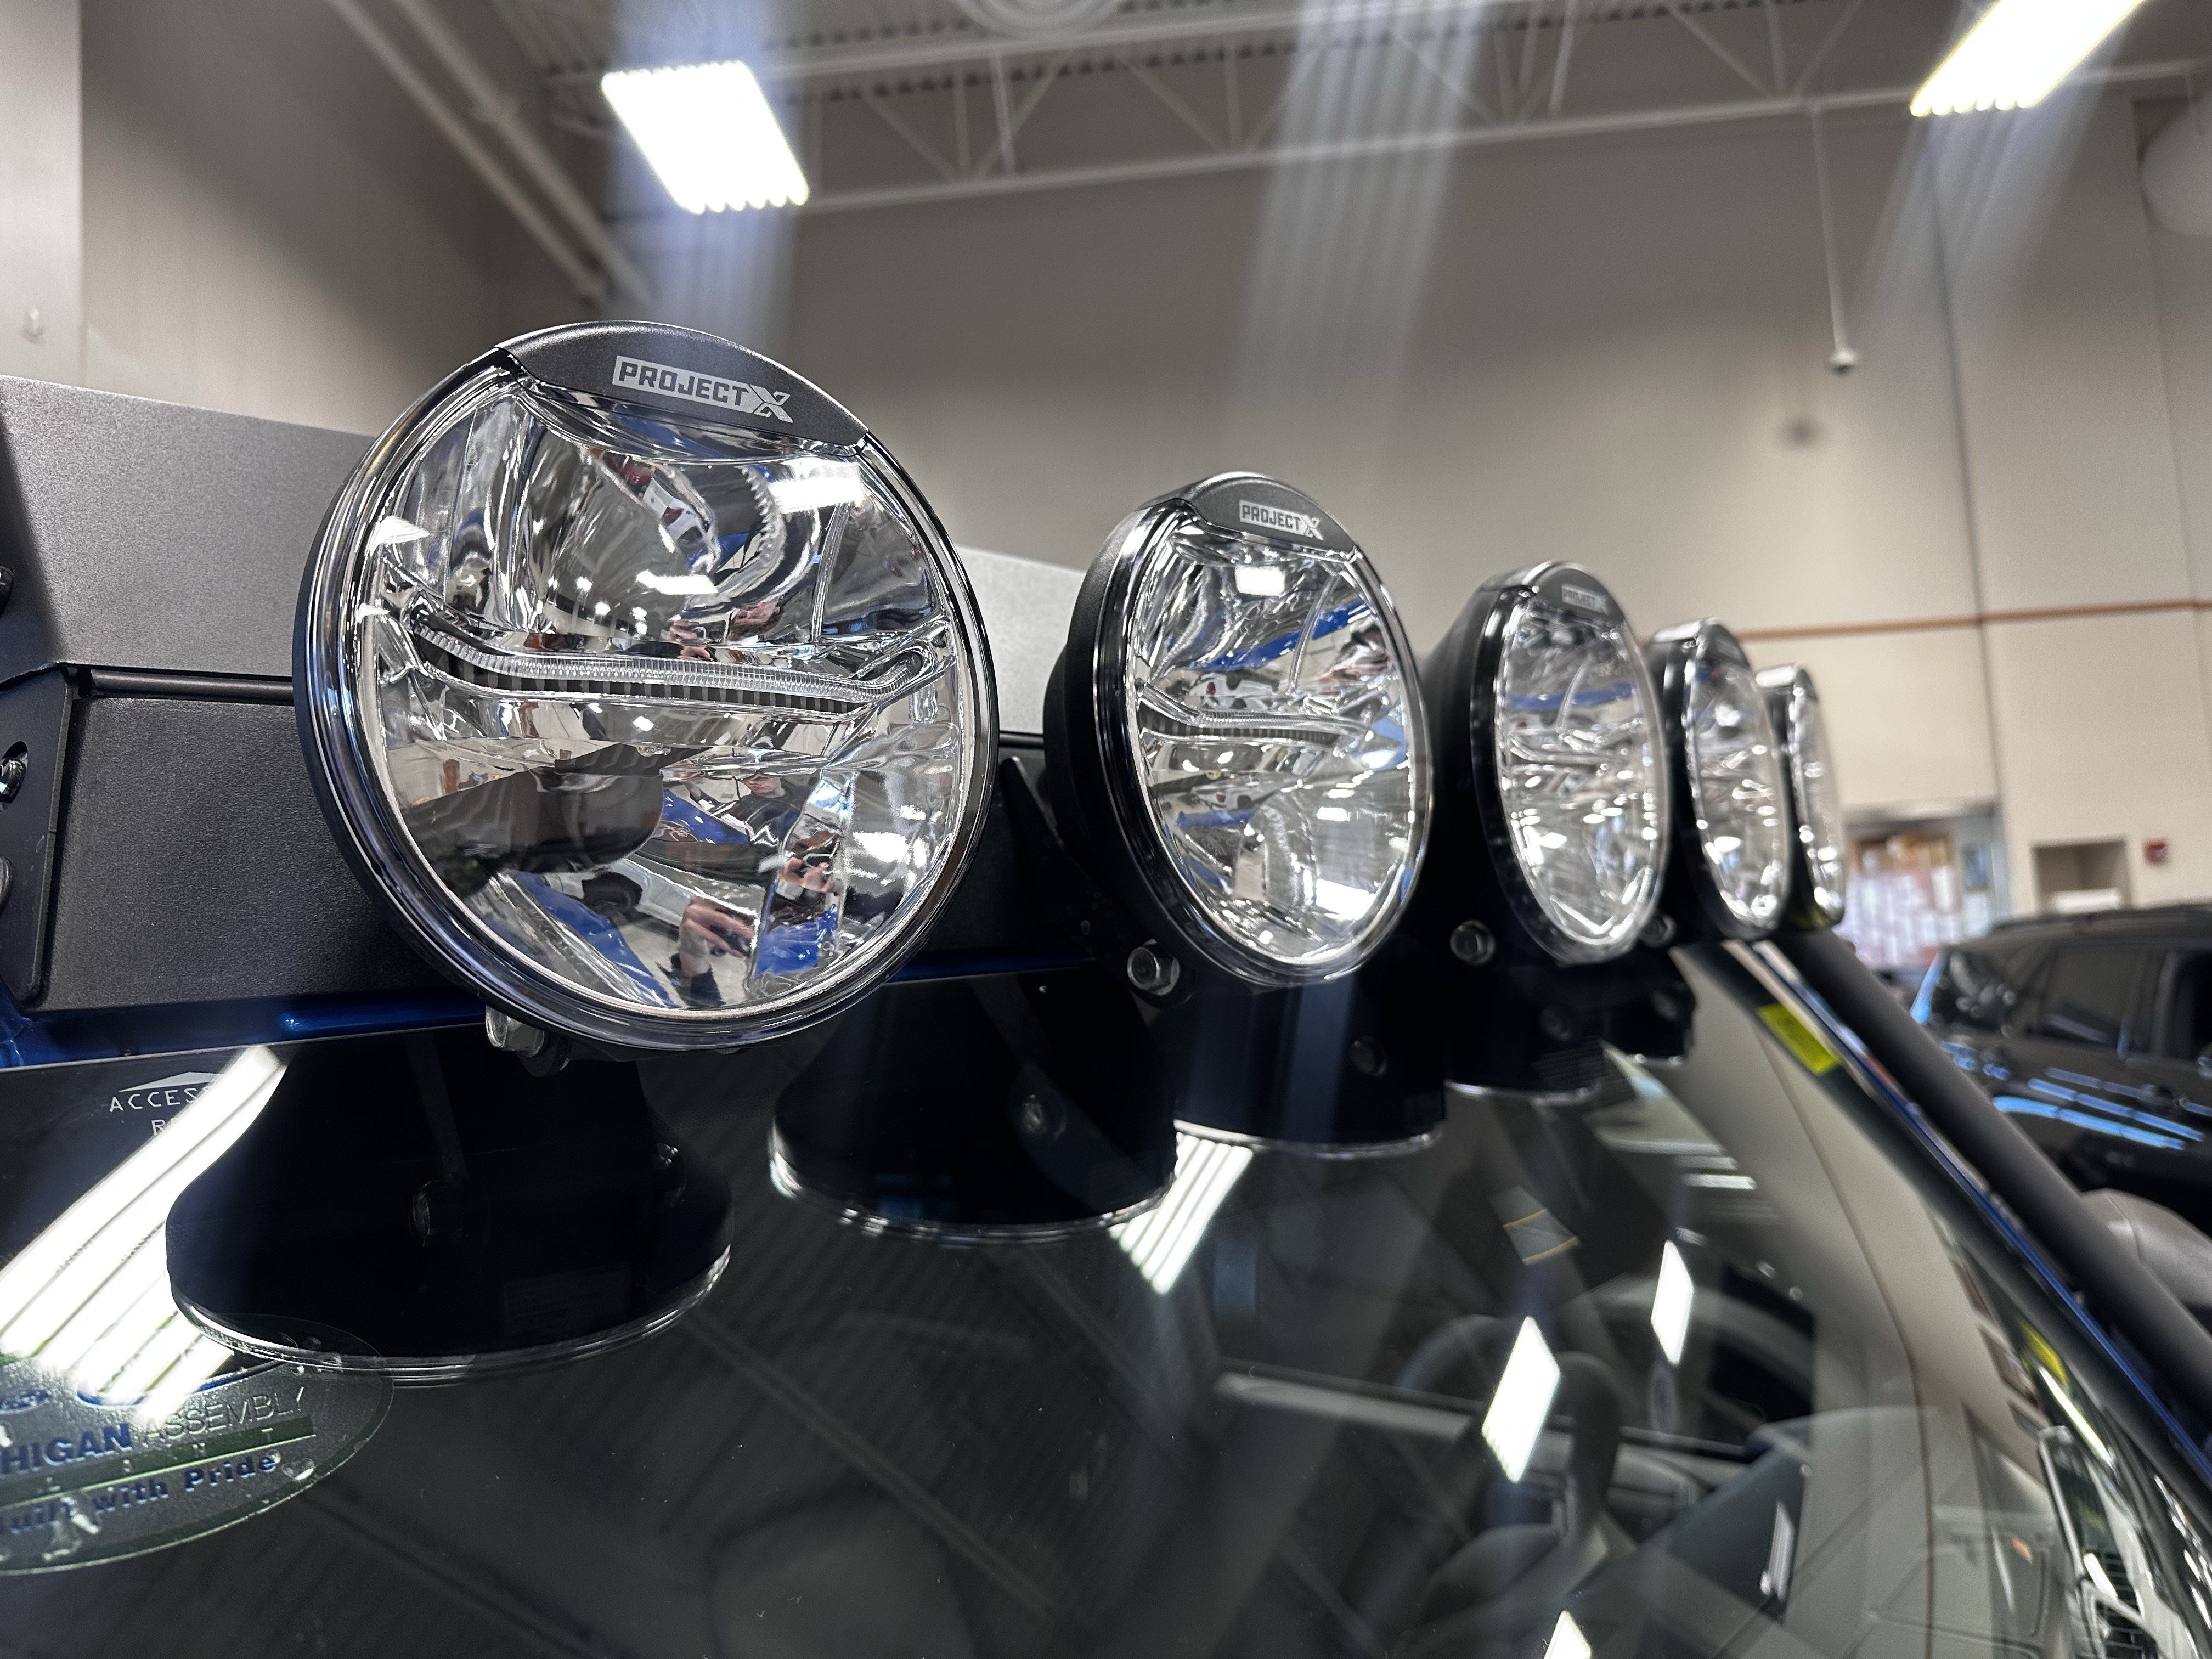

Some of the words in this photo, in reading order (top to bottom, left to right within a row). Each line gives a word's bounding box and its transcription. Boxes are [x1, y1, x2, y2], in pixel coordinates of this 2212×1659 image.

[109, 1087, 210, 1113] ACCES
[0, 1423, 132, 1477] HIGAN
[183, 1457, 276, 1492] Pride
